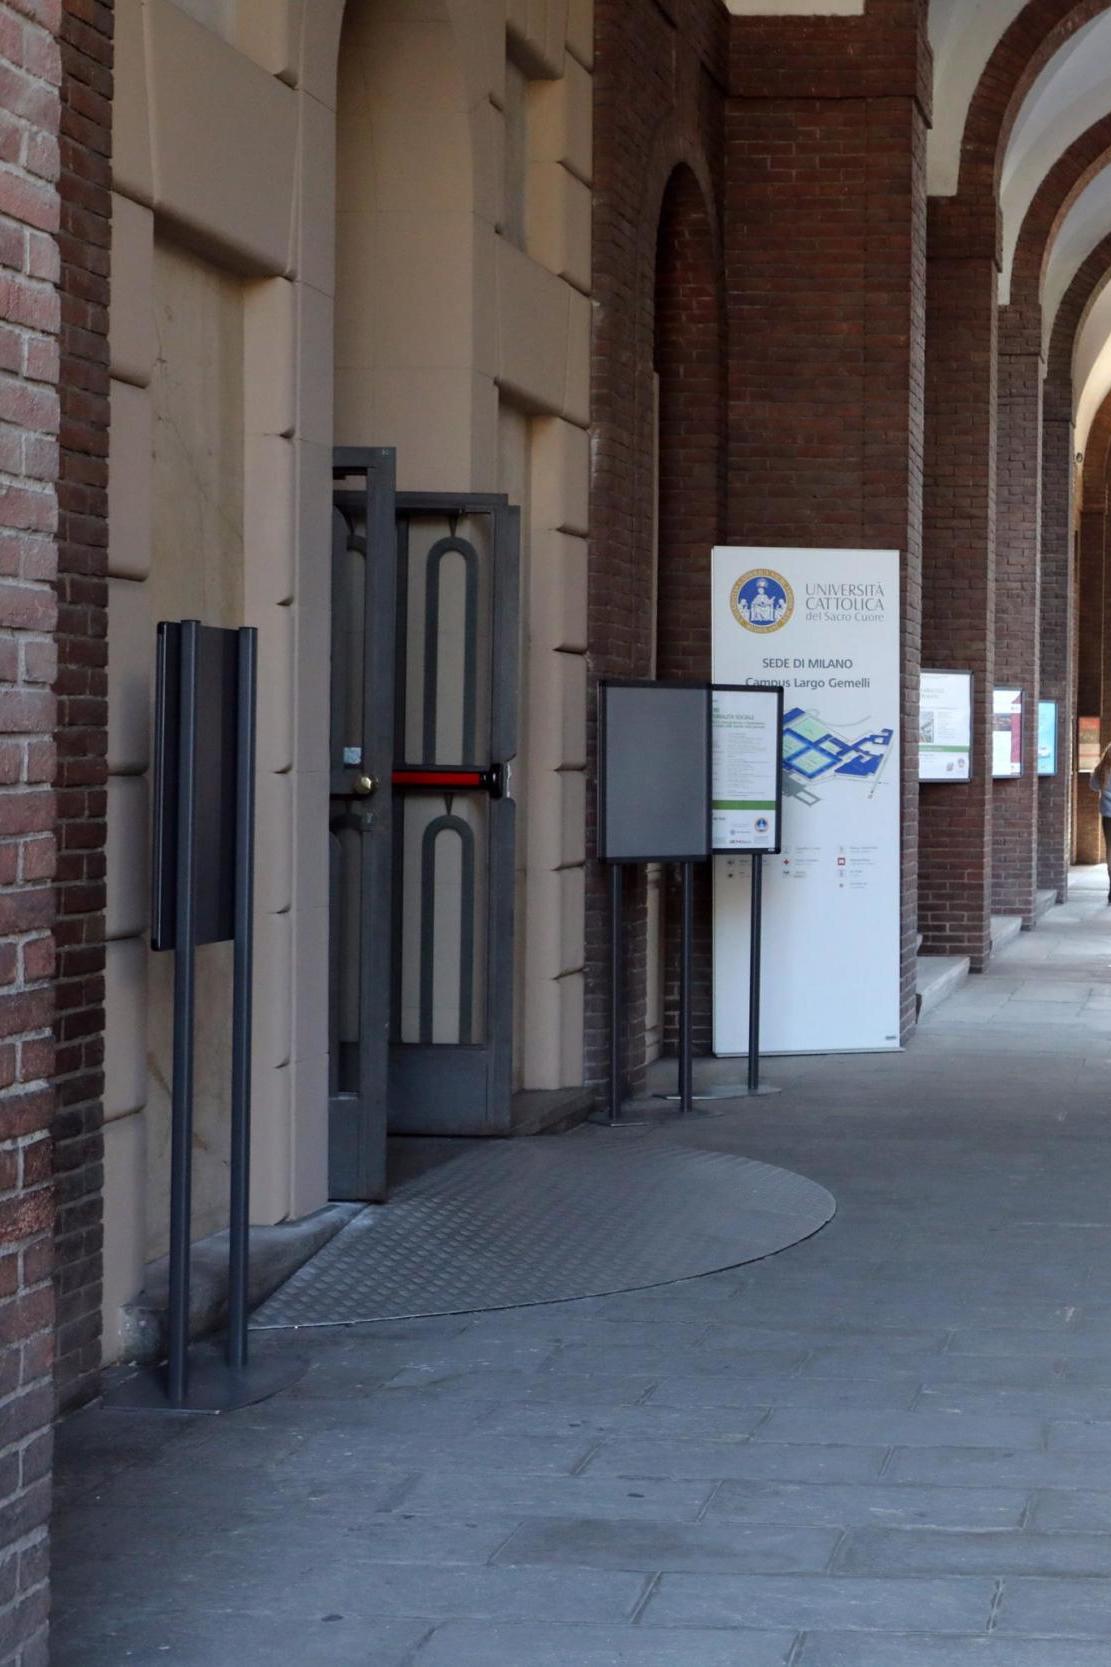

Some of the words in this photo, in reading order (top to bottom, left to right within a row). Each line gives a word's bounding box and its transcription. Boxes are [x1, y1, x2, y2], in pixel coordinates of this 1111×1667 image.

[805, 581, 885, 597] UNIVERSITÀ
[805, 597, 885, 611] CATTOLICA
[806, 612, 822, 621] del
[824, 612, 851, 621] Sacro
[854, 612, 885, 621] Cuore
[762, 658, 790, 669] SEDE
[793, 658, 805, 669] DI
[808, 658, 853, 669] MILANO
[745, 677, 791, 687] Campus
[794, 678, 825, 690] Largo
[828, 677, 870, 689] Gemelli
